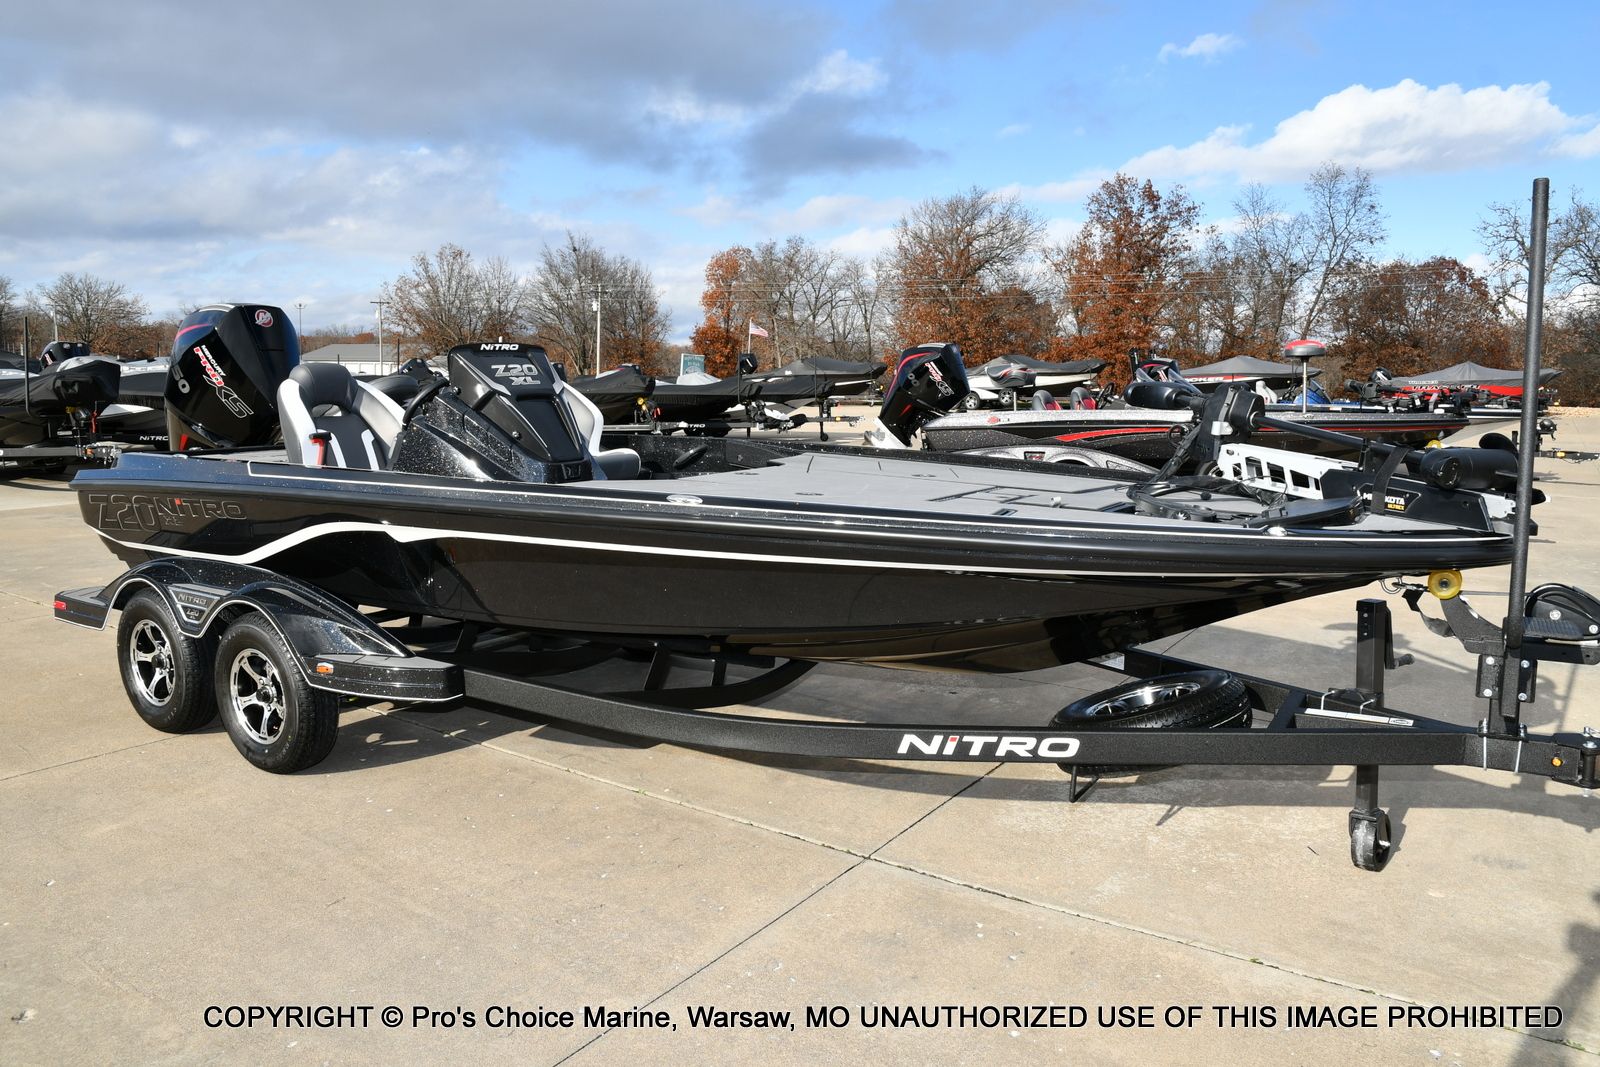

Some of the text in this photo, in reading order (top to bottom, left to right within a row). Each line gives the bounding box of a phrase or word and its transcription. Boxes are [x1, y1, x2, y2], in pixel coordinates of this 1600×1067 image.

[201, 344, 227, 377] MERCURY
[491, 363, 539, 377] Z20
[508, 376, 541, 386] XL
